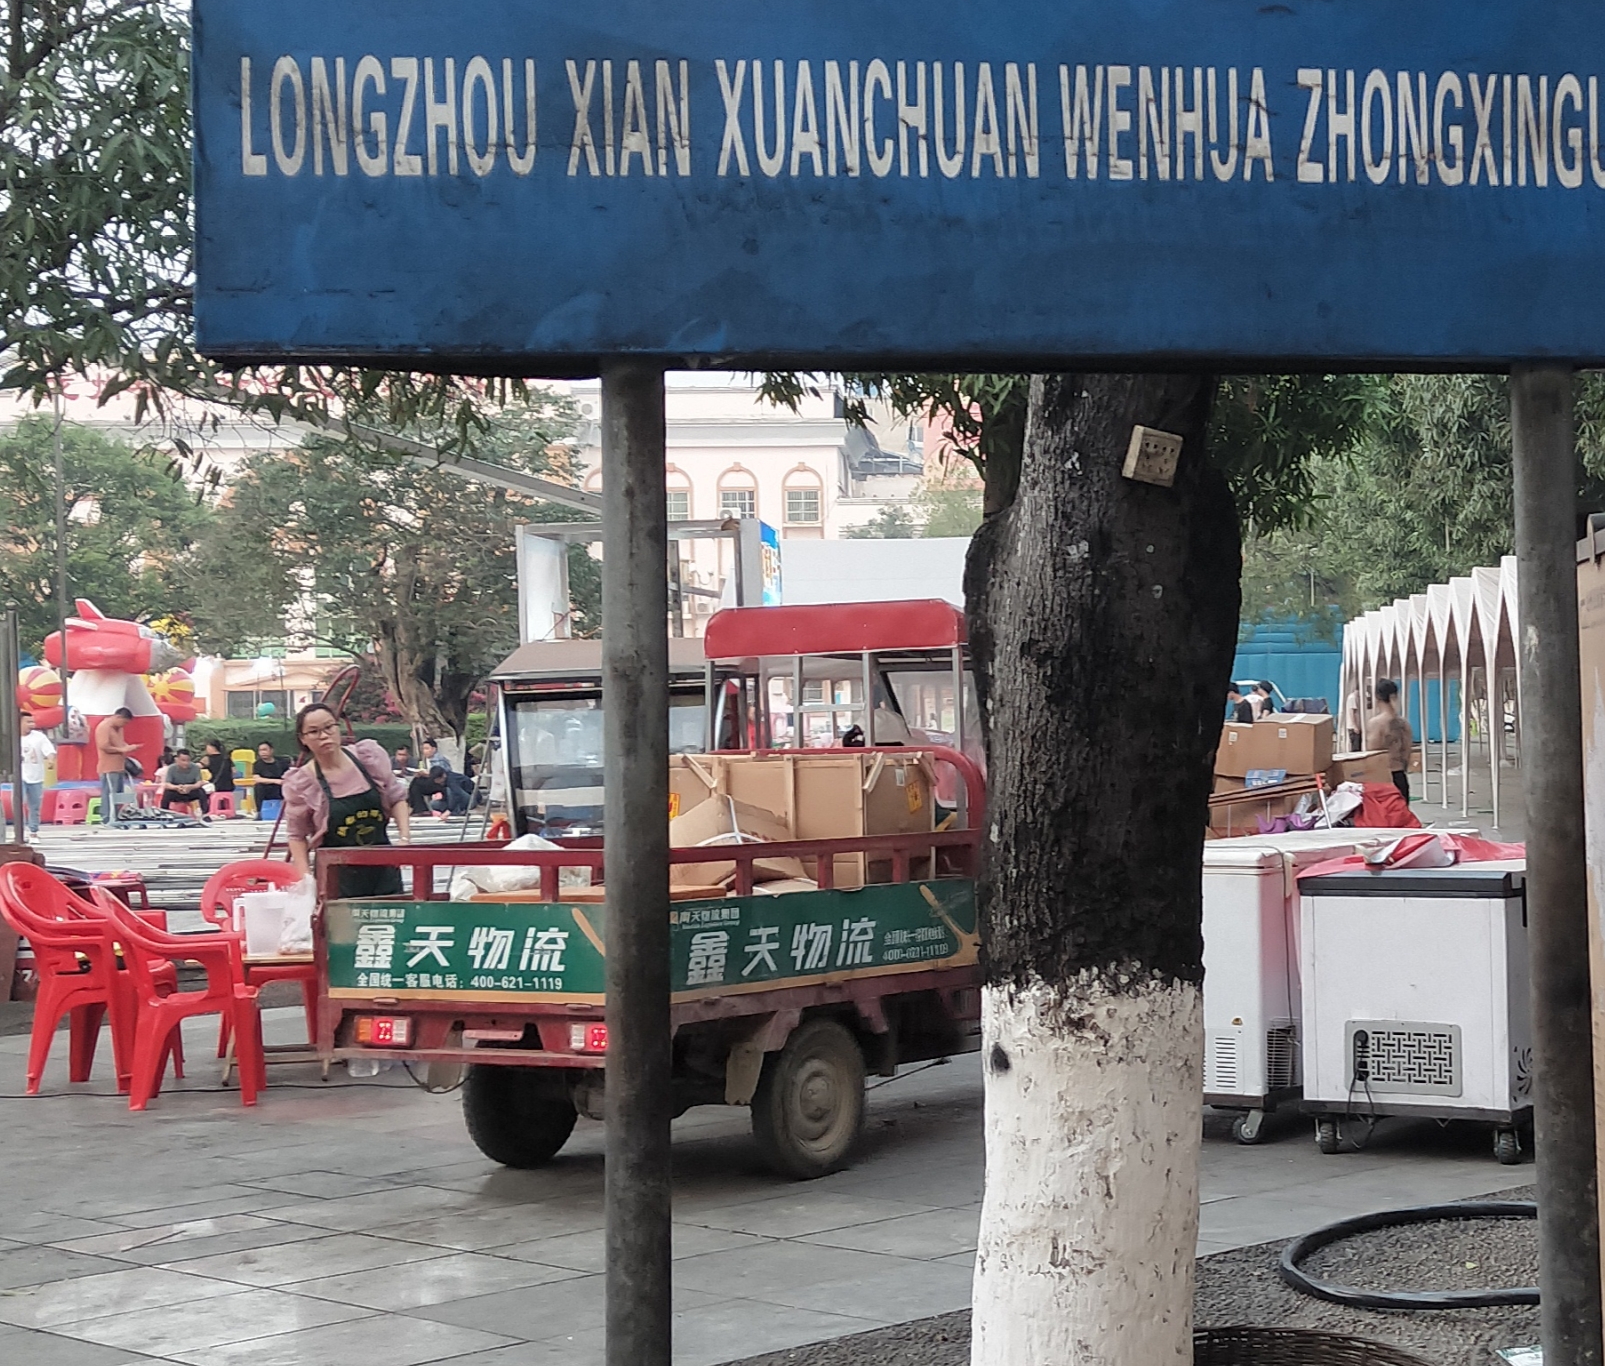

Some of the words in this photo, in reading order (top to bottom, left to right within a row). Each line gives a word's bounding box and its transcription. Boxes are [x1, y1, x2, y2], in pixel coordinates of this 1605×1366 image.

[240, 56, 536, 177] LONGZHOU
[566, 59, 691, 177] XIAN
[715, 59, 1038, 179] XUANCHUAN
[1059, 65, 1274, 183] WENHUA
[354, 924, 569, 973] 鑫天物流
[686, 917, 877, 986] 鑫天物流
